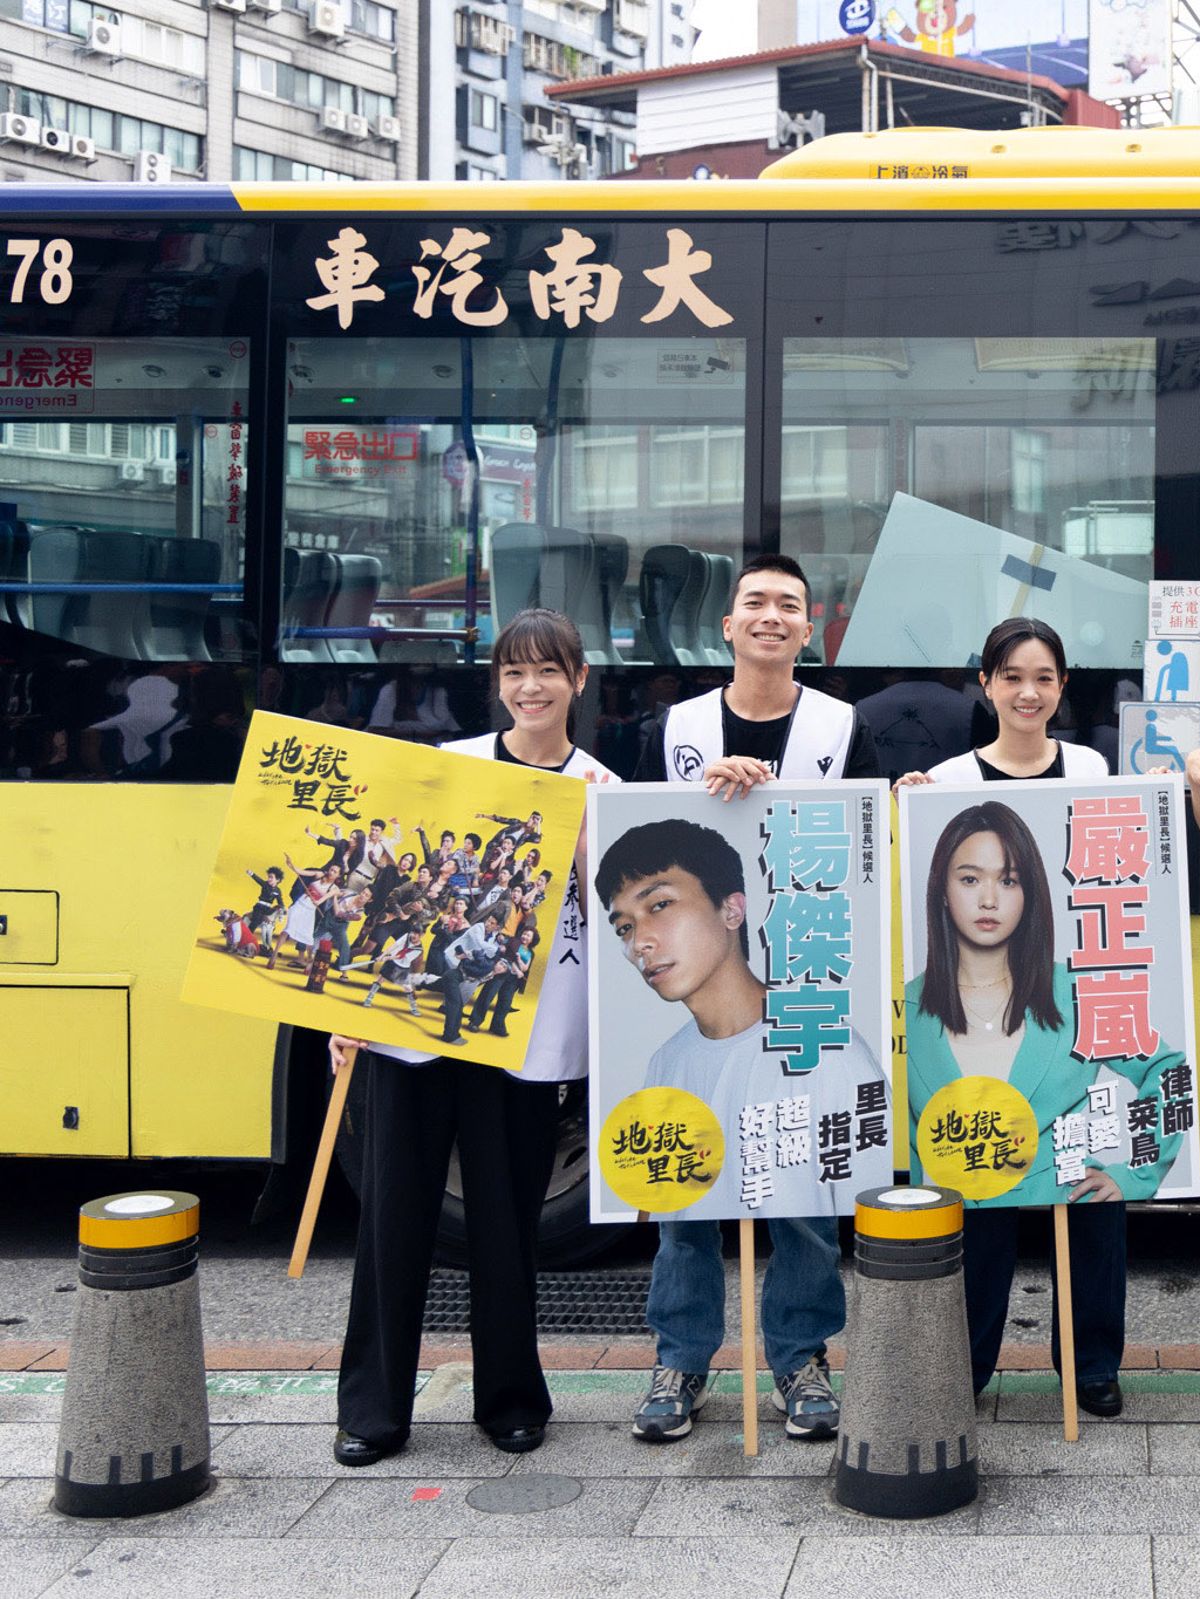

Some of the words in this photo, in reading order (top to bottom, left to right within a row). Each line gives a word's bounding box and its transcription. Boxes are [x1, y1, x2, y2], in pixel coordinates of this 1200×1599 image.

[6, 238, 74, 305] 78
[304, 431, 417, 461] 緊急出口
[315, 464, 380, 476] Emergency
[1169, 616, 1199, 629] 插座
[1170, 601, 1199, 614] 充電
[259, 736, 351, 782] 地獄
[287, 779, 361, 821] 里長
[761, 800, 853, 1074] 楊傑宇
[1065, 795, 1160, 1062] 嚴正嵐
[855, 1080, 887, 1152] 里長
[1086, 1080, 1121, 1153] 可愛
[1160, 1065, 1194, 1137] 律師
[612, 1121, 694, 1155] 地獄
[776, 1095, 811, 1168] 超級
[818, 1112, 852, 1183] 指定
[930, 1109, 1009, 1143] 地獄
[1127, 1096, 1160, 1168] 菜鳥
[646, 1152, 712, 1184] 里長
[964, 1139, 1027, 1172] 里長
